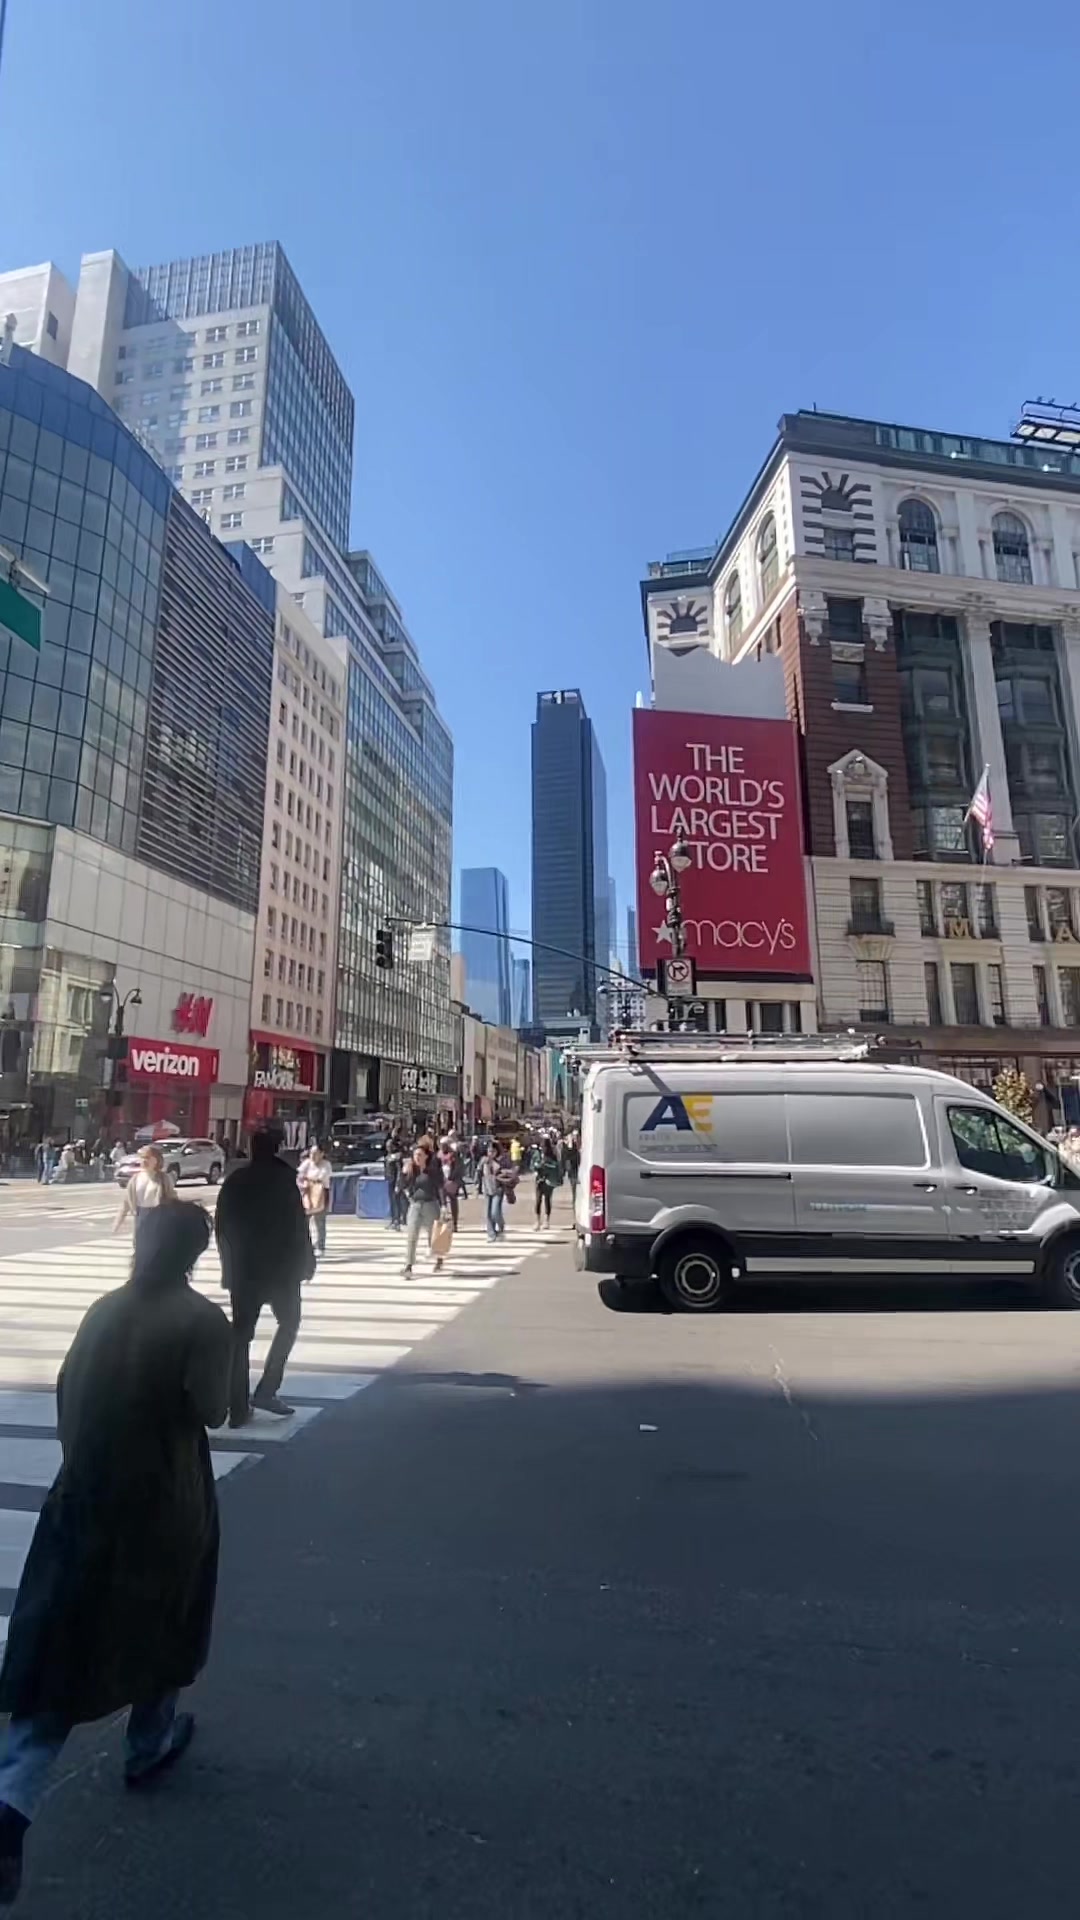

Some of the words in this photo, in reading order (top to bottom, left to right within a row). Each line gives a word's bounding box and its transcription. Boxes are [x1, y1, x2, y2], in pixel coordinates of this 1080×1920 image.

[686, 742, 745, 774] THE
[648, 772, 785, 809] WORLD'S
[651, 805, 783, 840] LARGEST
[683, 840, 769, 873] TORE
[681, 918, 796, 955] macy's
[131, 1046, 200, 1077] verizon
